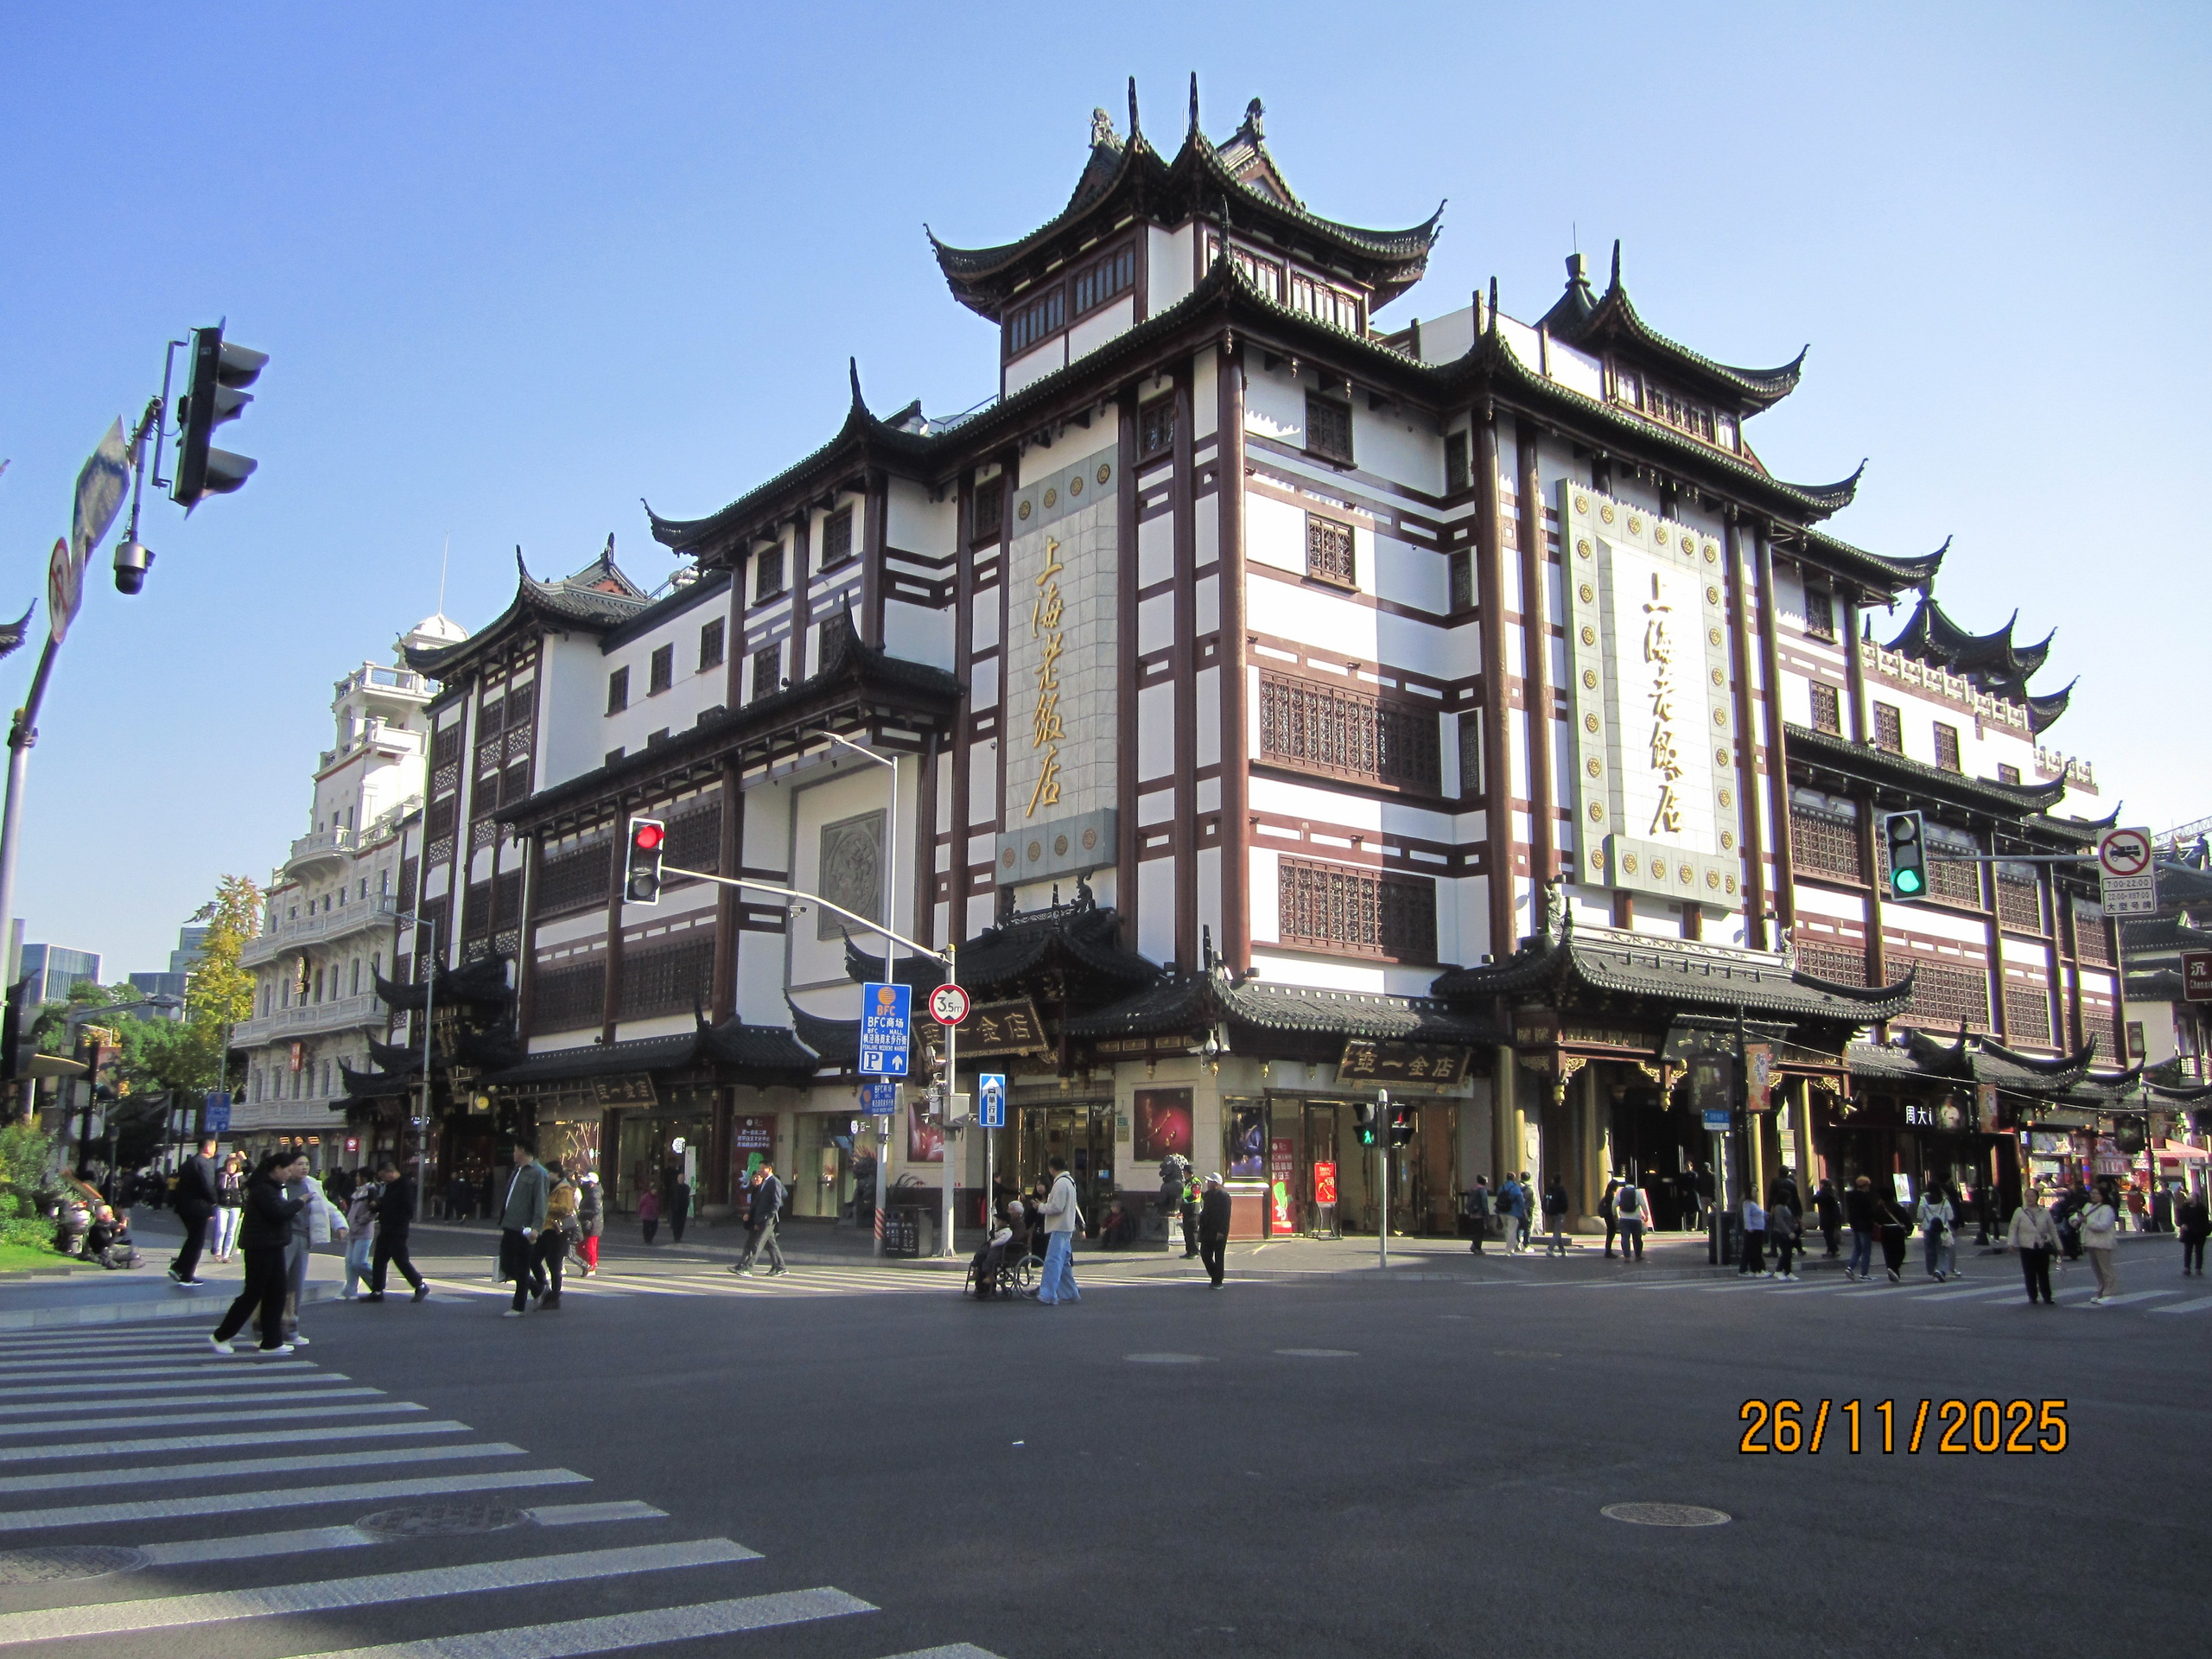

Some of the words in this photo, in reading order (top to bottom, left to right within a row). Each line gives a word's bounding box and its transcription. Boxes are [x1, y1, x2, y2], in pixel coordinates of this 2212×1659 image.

[2107, 879, 2149, 888] 7:00-22:00
[2107, 900, 2152, 912] 大型号牌
[876, 1004, 896, 1016] BFC
[937, 996, 963, 1013] 3.5m
[867, 1016, 904, 1028] BFC商场
[867, 1052, 880, 1070] P
